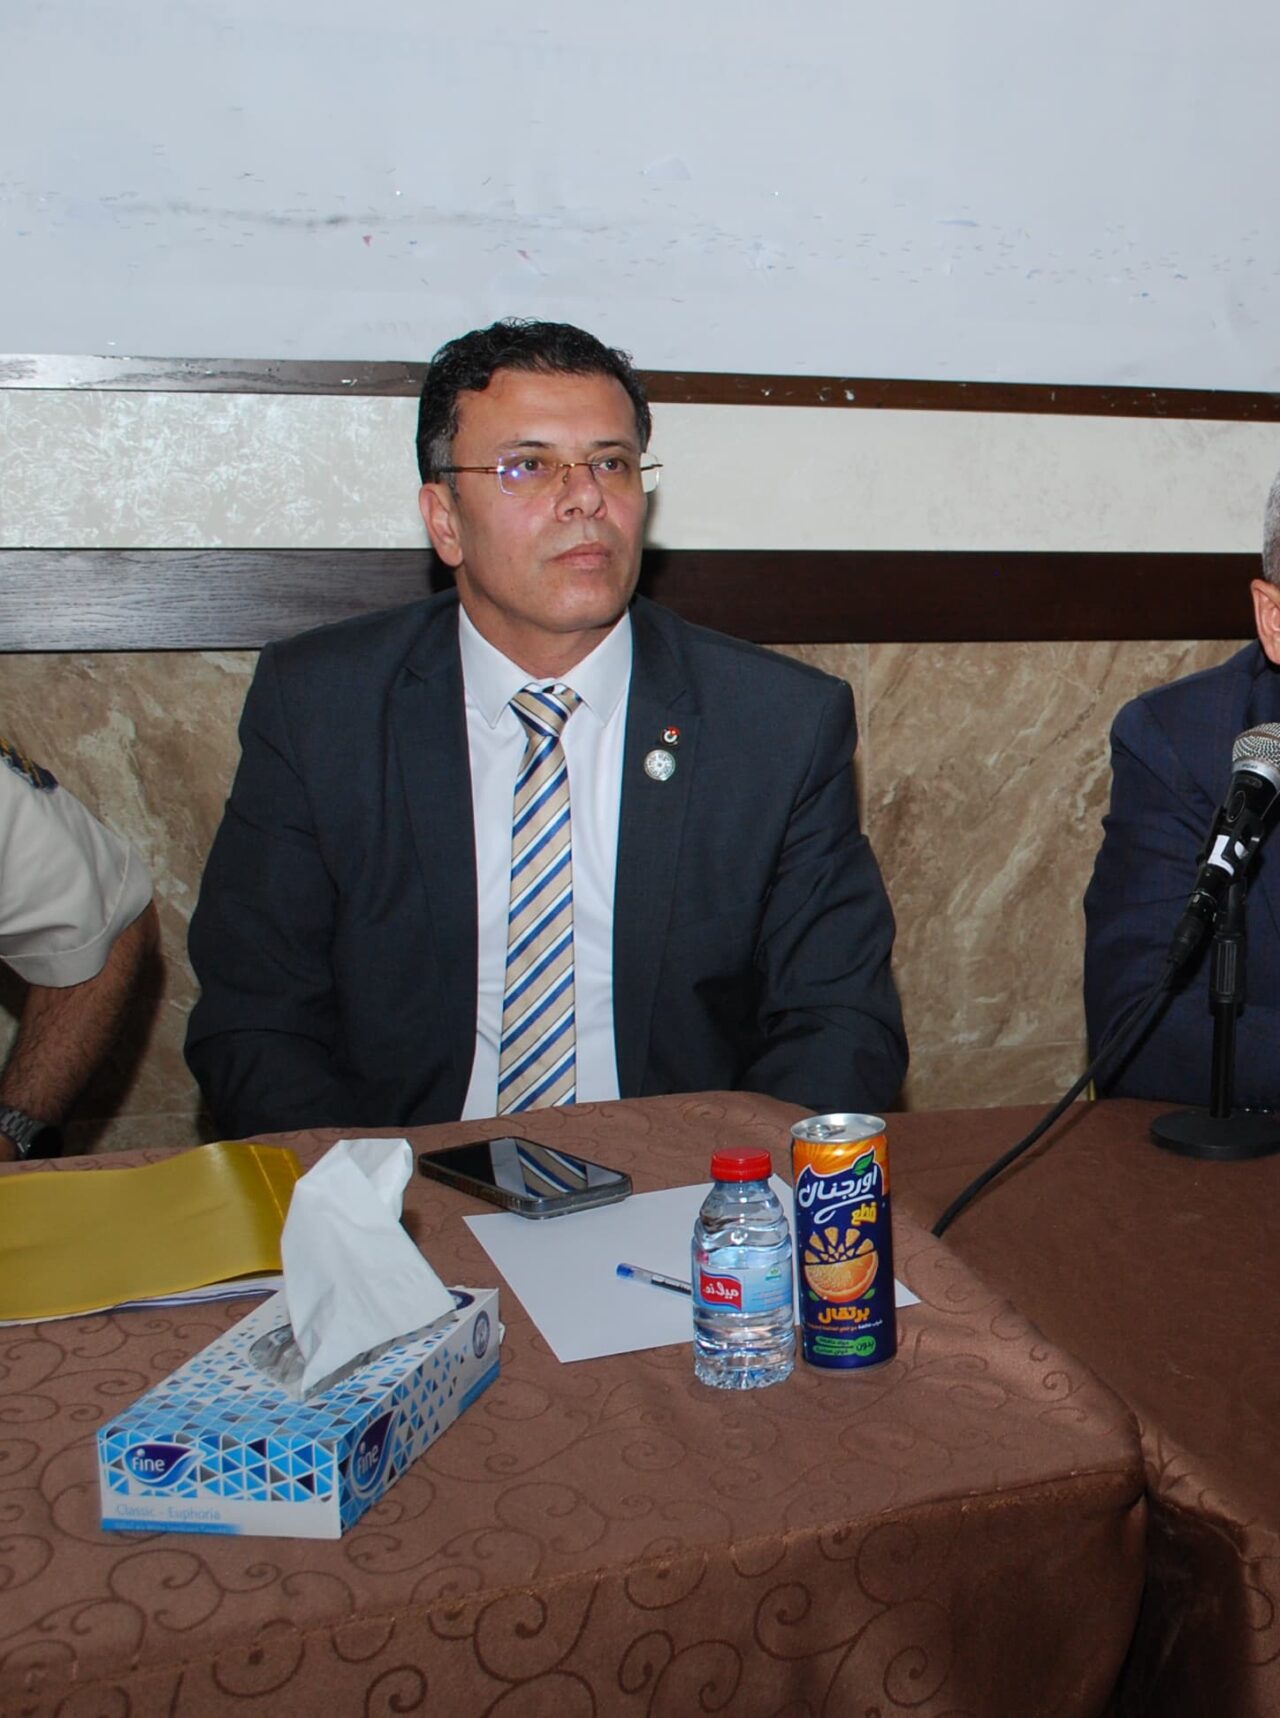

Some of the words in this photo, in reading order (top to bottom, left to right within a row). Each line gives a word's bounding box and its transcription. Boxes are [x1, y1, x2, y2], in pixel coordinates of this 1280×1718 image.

[817, 1306, 871, 1324] برتقال
[131, 1448, 166, 1472] fine
[357, 1440, 379, 1478] fine
